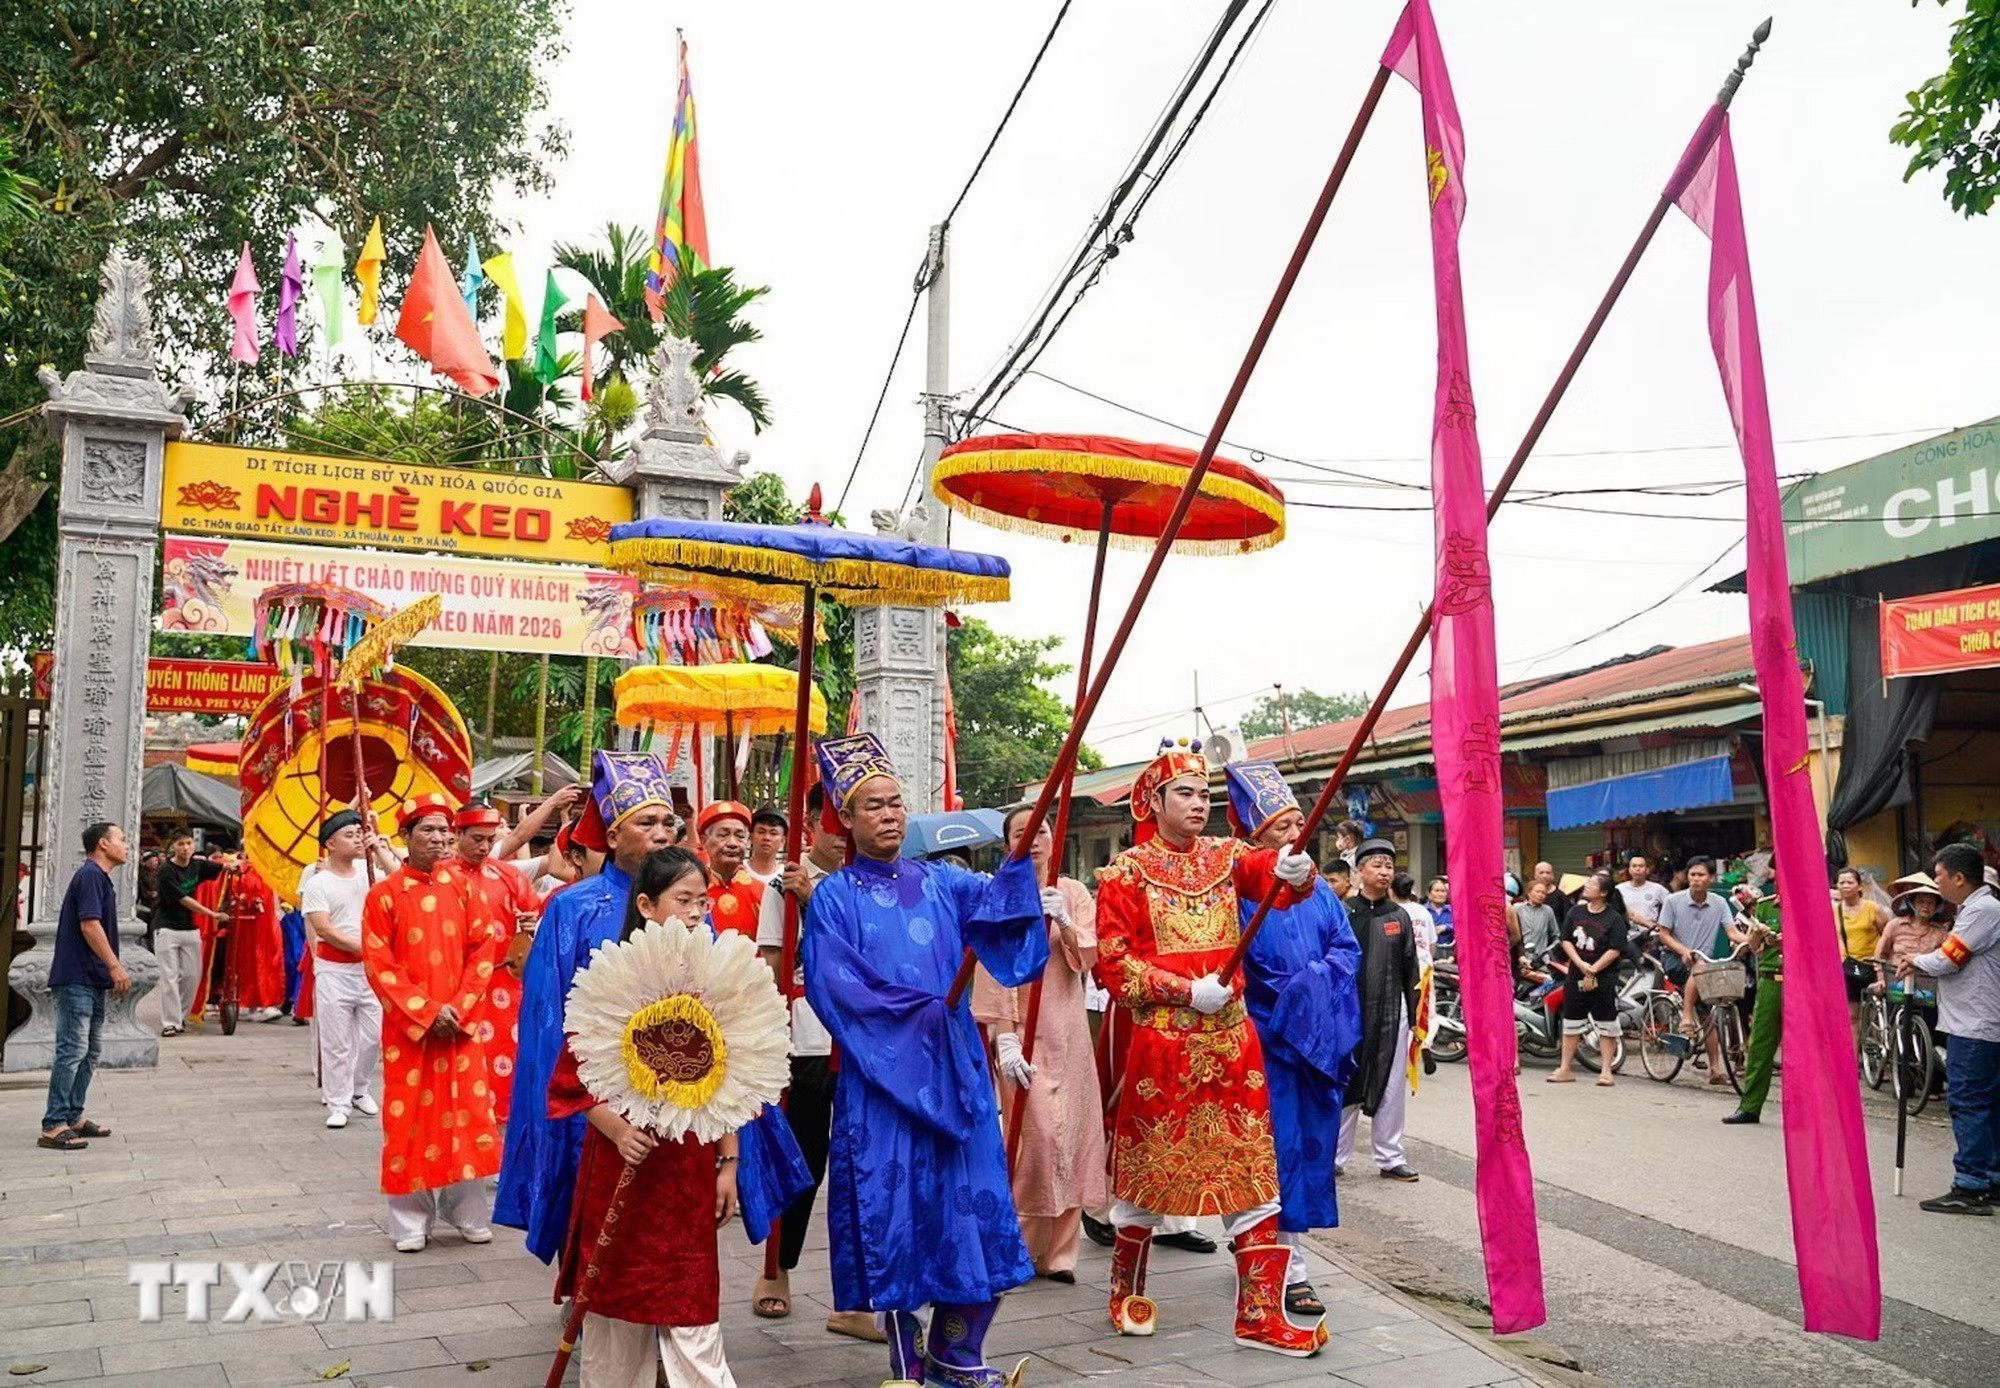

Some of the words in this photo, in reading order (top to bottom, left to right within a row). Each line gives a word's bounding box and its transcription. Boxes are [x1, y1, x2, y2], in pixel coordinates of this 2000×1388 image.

[247, 457, 266, 471] DI
[273, 457, 317, 475] TÍCH
[323, 465, 365, 482] LỊCH
[371, 465, 395, 482] SỬ
[400, 471, 434, 486] VĂN
[440, 473, 476, 491] HÓA
[482, 477, 528, 496] QUỐC
[534, 487, 563, 499] GIA
[256, 483, 420, 532] NGHÈ
[441, 500, 551, 542] KEO
[1883, 468, 2000, 539] CH
[204, 517, 232, 530] THÔN
[236, 521, 260, 533] GIAO
[344, 529, 356, 539] XÃ
[391, 534, 404, 544] AN
[426, 537, 440, 546] HÀ
[355, 564, 404, 590] CHÀO
[411, 567, 465, 595] MỪNG
[471, 573, 505, 599] QUÝ
[510, 576, 569, 603] KHÁCH
[472, 612, 514, 636] NĂM
[519, 616, 562, 639] 2026
[1934, 604, 1957, 627] DÂN
[1960, 600, 1985, 622] TÍCH
[186, 666, 229, 691] THỐNG
[231, 670, 266, 693] LÀNG
[148, 694, 170, 707] ĂN
[174, 695, 202, 708] HÓA
[205, 698, 228, 708] PHI
[231, 697, 260, 710] VẬT
